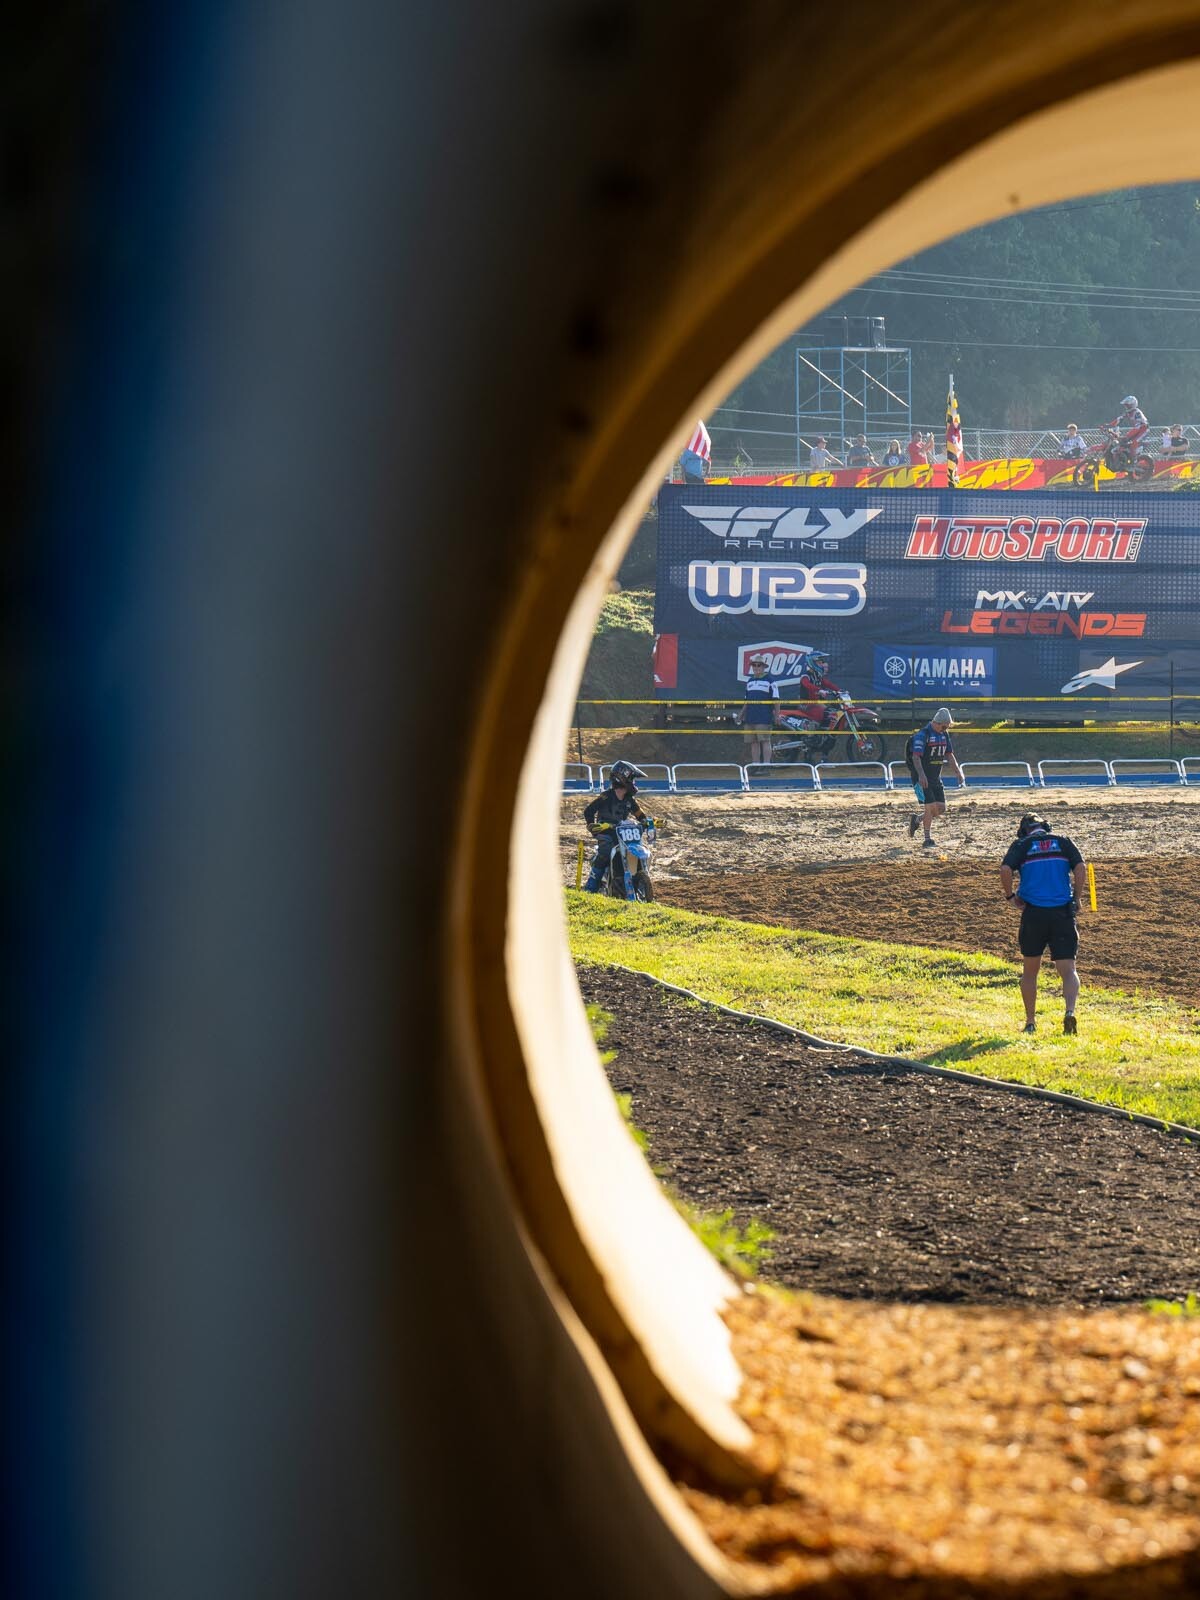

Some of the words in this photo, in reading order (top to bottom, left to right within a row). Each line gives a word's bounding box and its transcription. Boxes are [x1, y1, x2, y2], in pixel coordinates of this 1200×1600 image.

[680, 505, 885, 539] FLY
[724, 540, 839, 550] RACING
[689, 560, 867, 616] WPS
[974, 591, 1026, 610] MX
[1033, 592, 1095, 610] ATV
[940, 611, 1148, 640] LEGENDS
[908, 658, 986, 678] YAMAHA
[620, 828, 641, 841] 188
